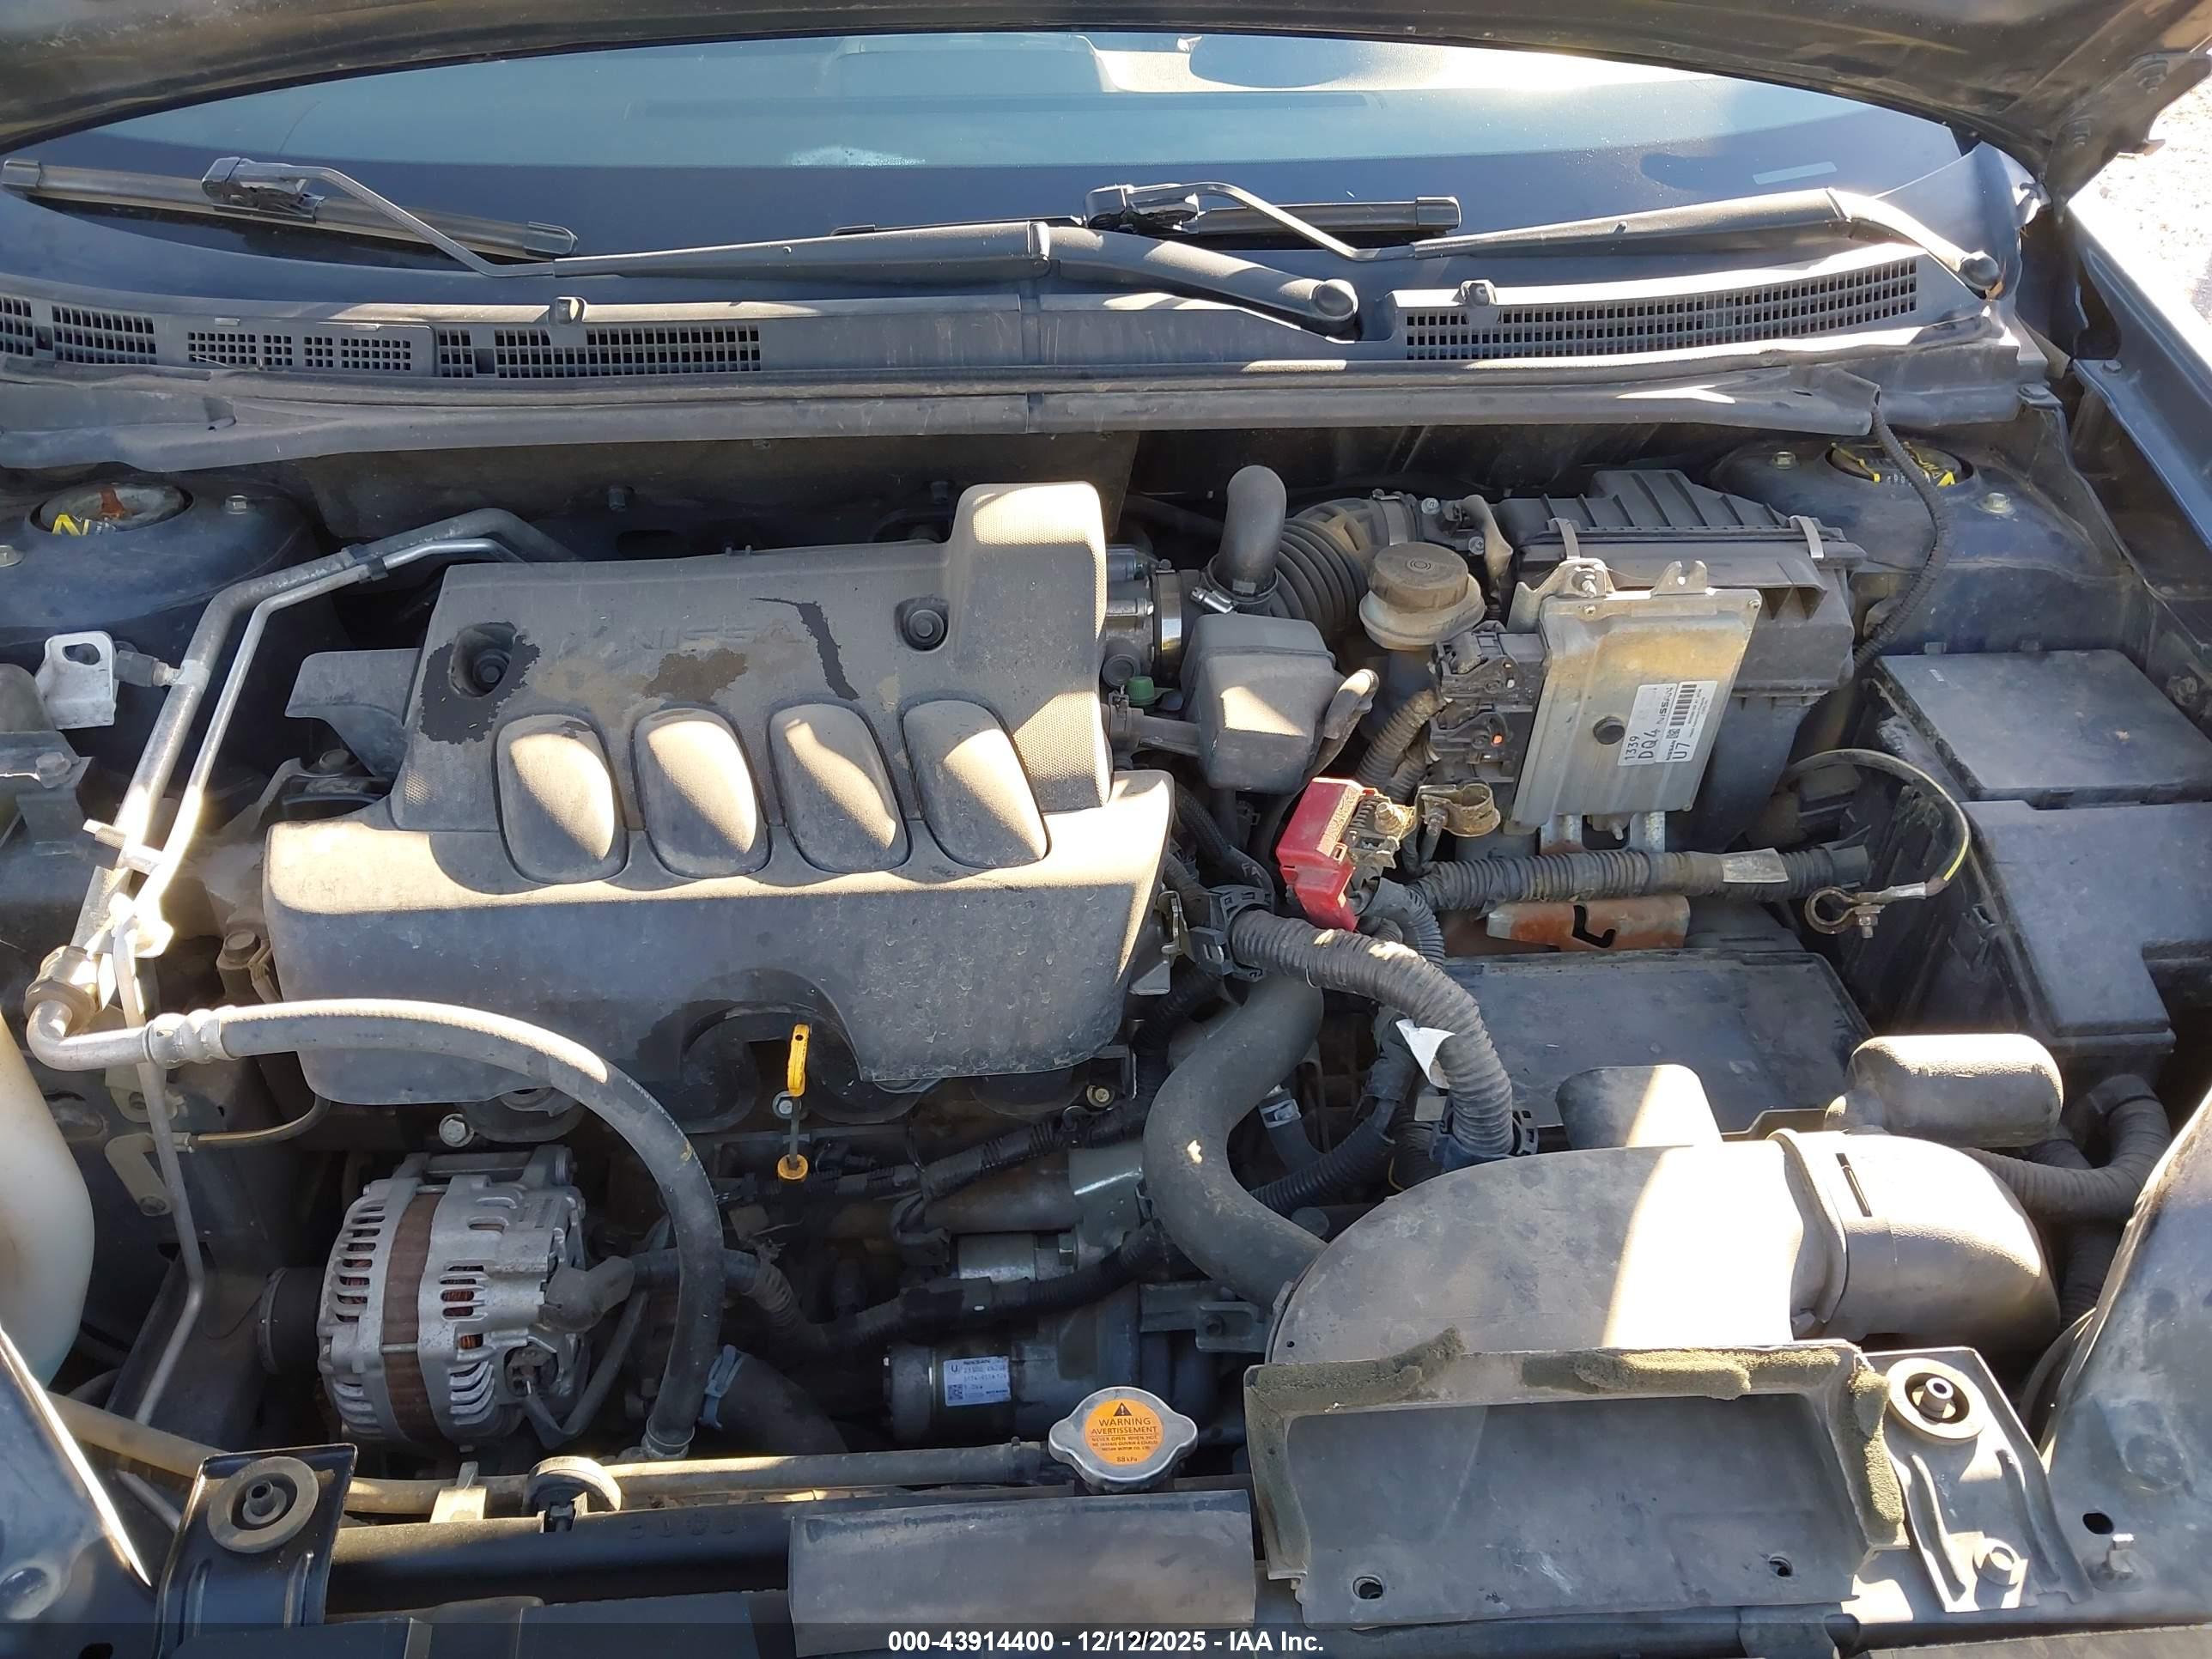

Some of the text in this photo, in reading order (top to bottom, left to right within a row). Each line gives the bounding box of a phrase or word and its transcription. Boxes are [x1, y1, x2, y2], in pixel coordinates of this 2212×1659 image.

[1656, 687, 1674, 725] NISSAN
[1625, 736, 1640, 760] 1339
[1638, 728, 1661, 759] DQ4
[1672, 743, 1691, 759] U7
[1099, 1418, 1152, 1426] WARNING
